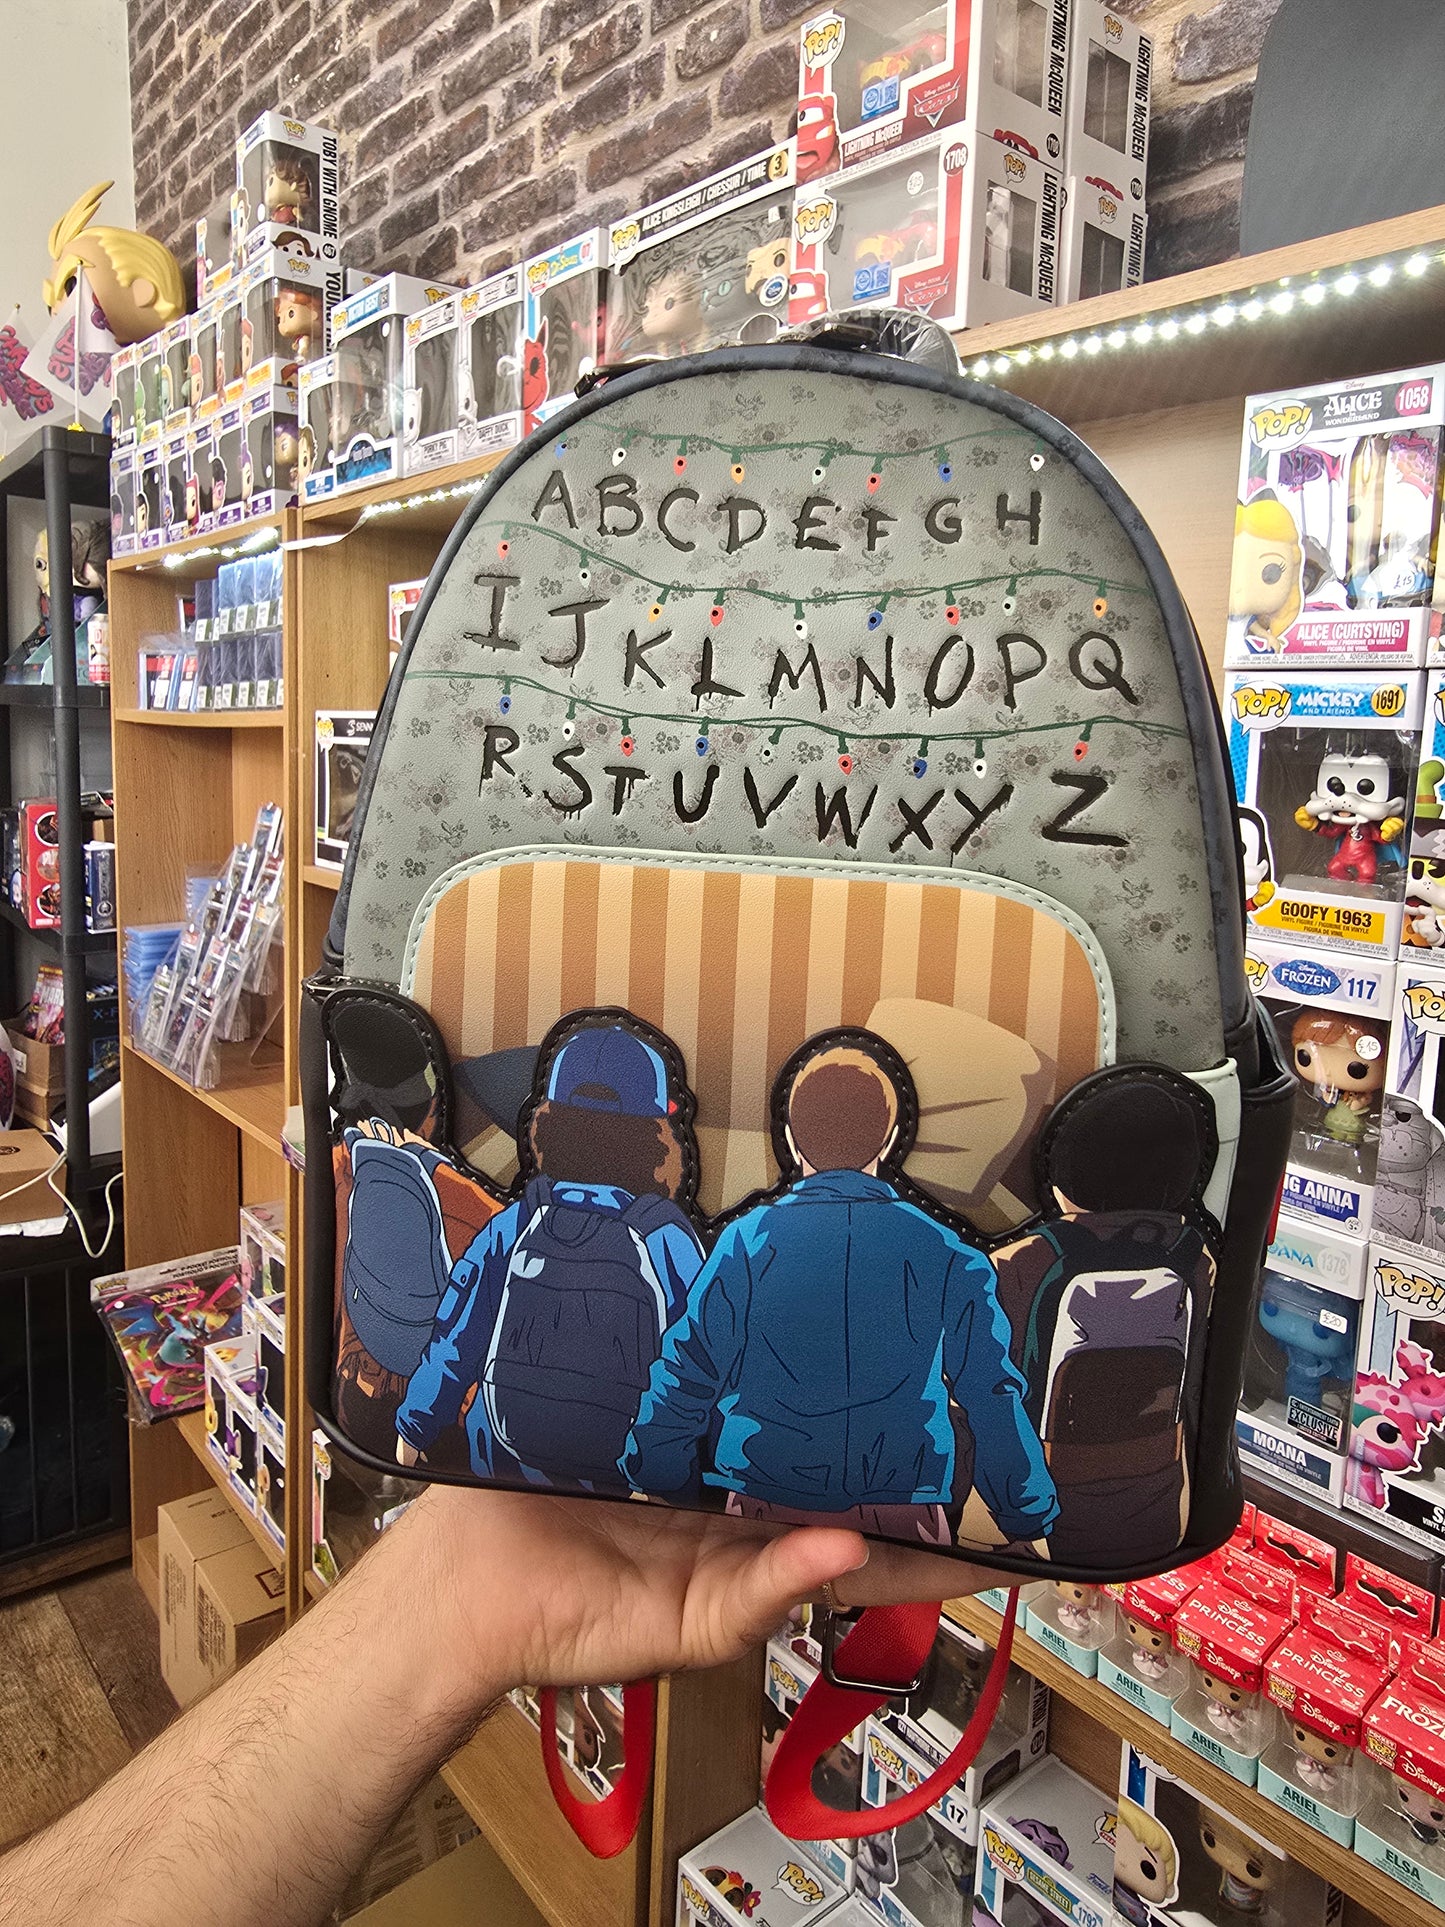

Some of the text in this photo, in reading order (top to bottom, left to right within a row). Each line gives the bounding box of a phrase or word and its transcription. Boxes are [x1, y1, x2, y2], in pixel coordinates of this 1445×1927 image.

[803, 20, 843, 64] POP!
[1103, 15, 1124, 40] POP!
[1134, 35, 1152, 102] LIGHTNING
[844, 131, 875, 157] LIGHTNING
[945, 144, 968, 171] 1708
[1004, 153, 1027, 178] POP!
[322, 136, 338, 239] TOBY WITH GNOME
[642, 213, 662, 231] ALICE
[746, 161, 767, 183] TIME
[795, 202, 834, 239] POP!
[1040, 172, 1058, 241] LIGHTNING
[611, 223, 640, 255] POP!
[1127, 212, 1144, 277] LIGHTNING
[1344, 380, 1366, 390] Disney
[1398, 384, 1429, 411] 1058
[1323, 390, 1383, 418] ALICE
[1325, 412, 1380, 427] WONDERLAND
[1250, 405, 1312, 443] POP!
[1297, 620, 1405, 641] ALICE (CURTSYING)
[1231, 687, 1292, 719] POP!
[1295, 692, 1366, 708] MICKEY
[1321, 707, 1356, 715] FRIENDS
[1375, 689, 1401, 711] 1691
[1280, 901, 1372, 928] GOOFY 1963
[1281, 969, 1333, 988] FROZEN
[1298, 963, 1317, 974] Disney
[1347, 976, 1377, 1000] 117
[1402, 986, 1445, 1021] PO
[1303, 1183, 1354, 1210] ANNA
[1267, 1244, 1314, 1269] OANA
[1374, 1266, 1445, 1311] POP!
[1289, 1407, 1338, 1439] EXCLUSIVE
[1253, 1429, 1307, 1467] MOANA
[1130, 1590, 1162, 1623] Disney
[1188, 1598, 1267, 1647] PRINCESS
[1218, 1600, 1255, 1628] Disney
[1041, 1626, 1068, 1652] ARIEL
[770, 1660, 801, 1697] POP!
[1203, 1646, 1242, 1681] Disney
[1279, 1647, 1366, 1699] PRINCESS
[1310, 1649, 1351, 1679] Disney
[1115, 1672, 1147, 1700] ARIEL
[1298, 1697, 1341, 1734] Disney
[1381, 1695, 1445, 1741] FROZ
[868, 1733, 903, 1774] POP!
[1191, 1730, 1226, 1760] ARIEL
[1400, 1753, 1445, 1795] Disney
[949, 1805, 965, 1823] 17
[1282, 1785, 1321, 1817] ARIEL
[984, 1827, 1026, 1874] POP!
[1385, 1848, 1421, 1882] ELSA
[681, 1877, 710, 1917] POP!
[780, 1861, 826, 1903] POP!
